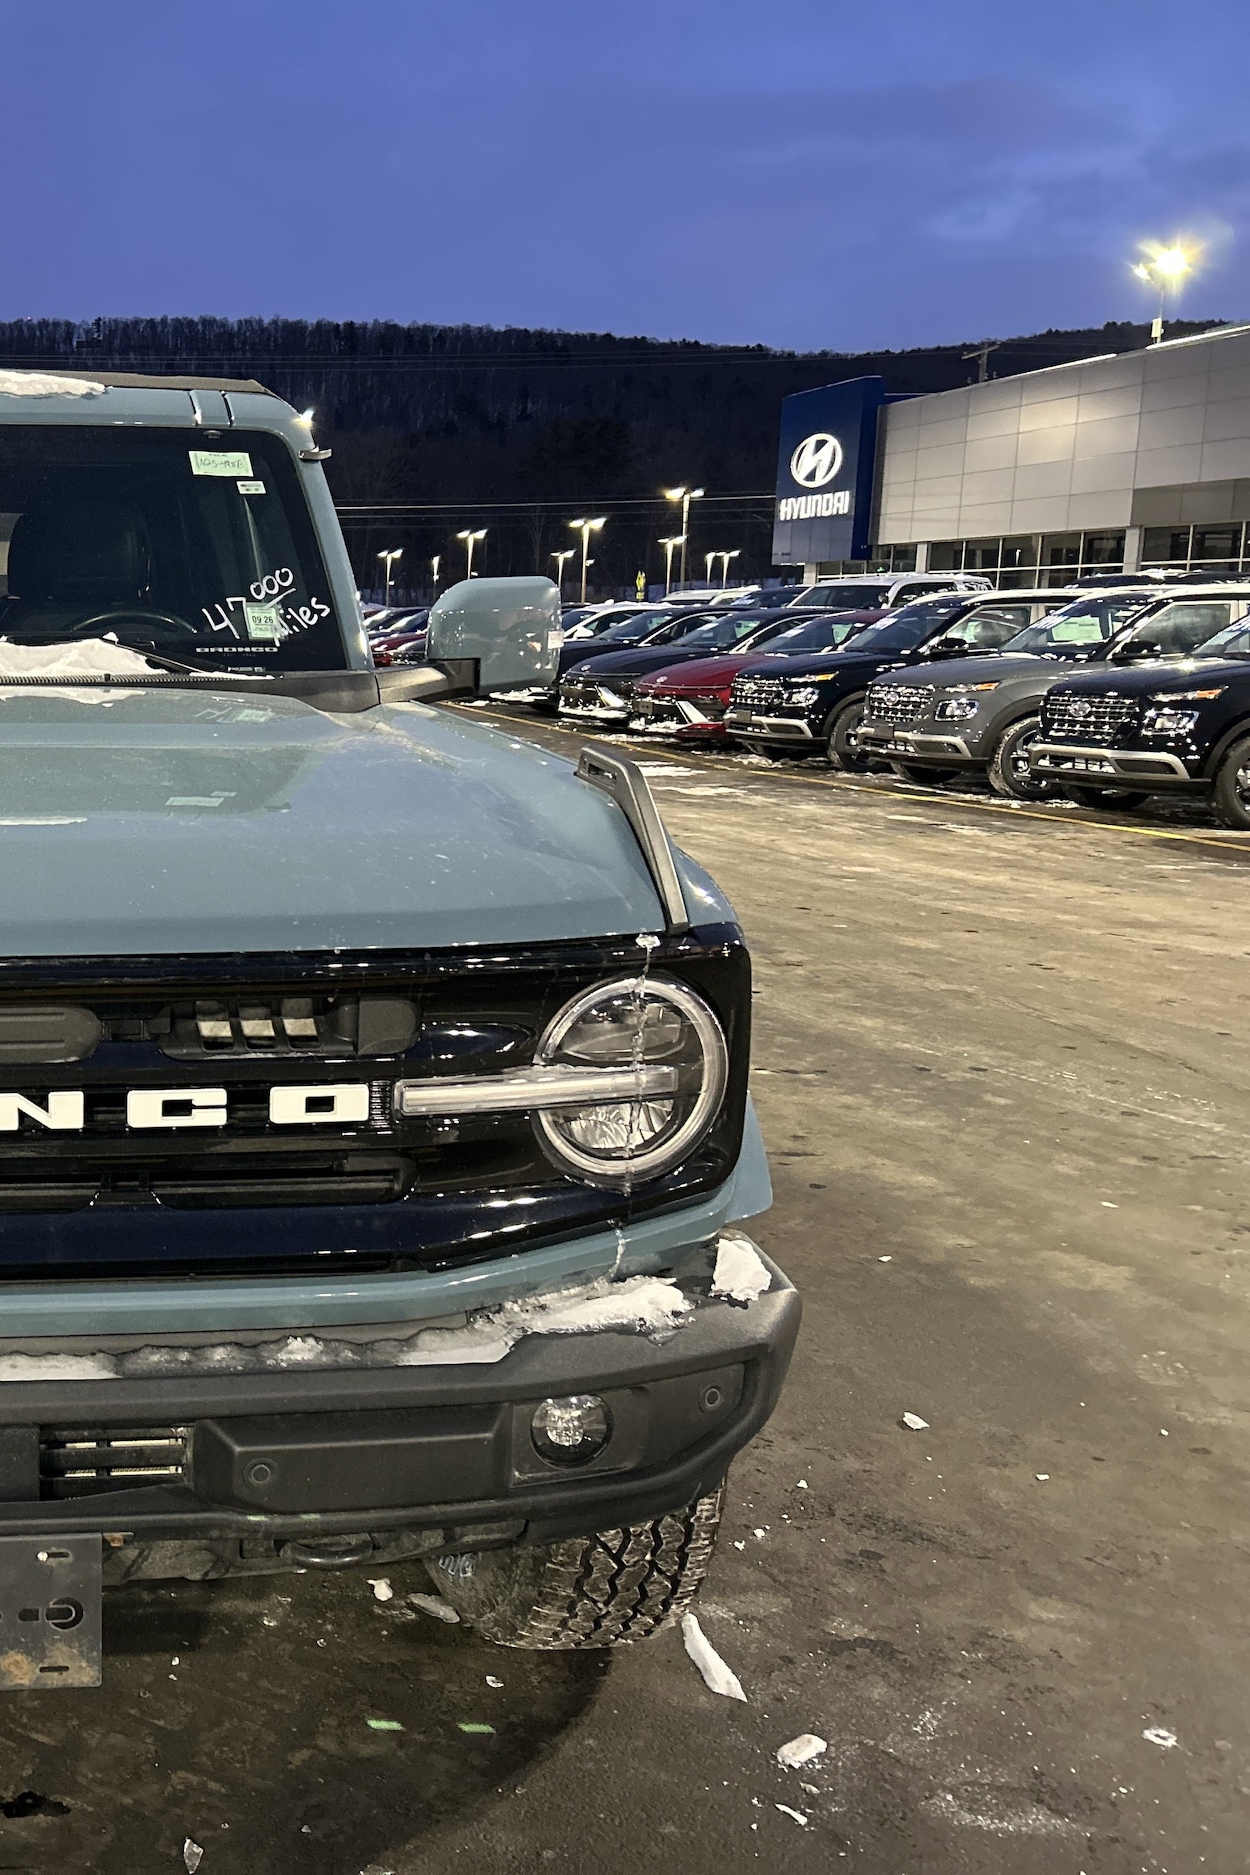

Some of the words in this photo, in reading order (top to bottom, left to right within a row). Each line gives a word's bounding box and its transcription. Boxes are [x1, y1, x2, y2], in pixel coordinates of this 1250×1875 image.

[779, 490, 850, 521] HYUNDAI
[252, 616, 262, 624] 09
[264, 616, 274, 624] 26
